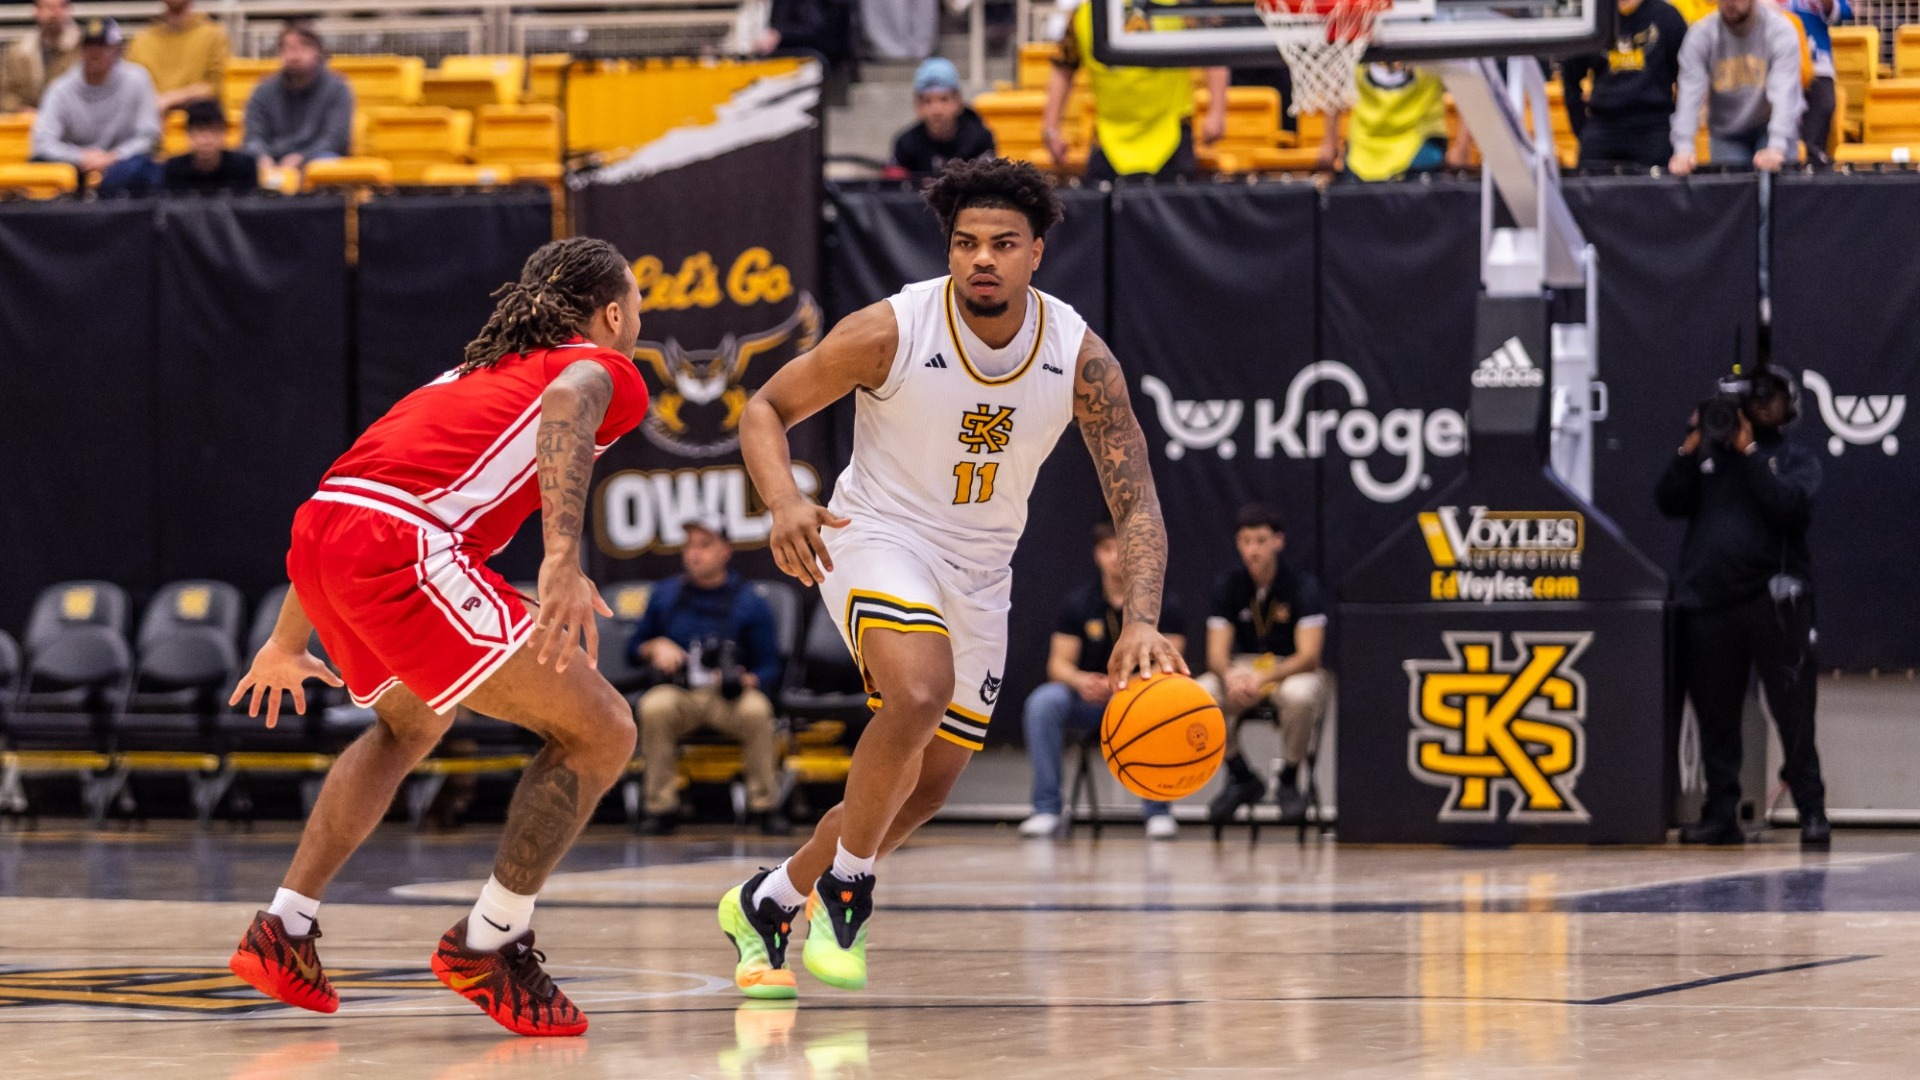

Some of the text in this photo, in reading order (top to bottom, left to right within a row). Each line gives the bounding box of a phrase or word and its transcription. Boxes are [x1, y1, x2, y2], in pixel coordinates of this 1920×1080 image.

[726, 247, 794, 306] Go
[1471, 367, 1545, 388] adidas
[1254, 360, 1470, 503] Kroge
[952, 461, 999, 505] 11
[1431, 570, 1579, 605] EdVoyles.com
